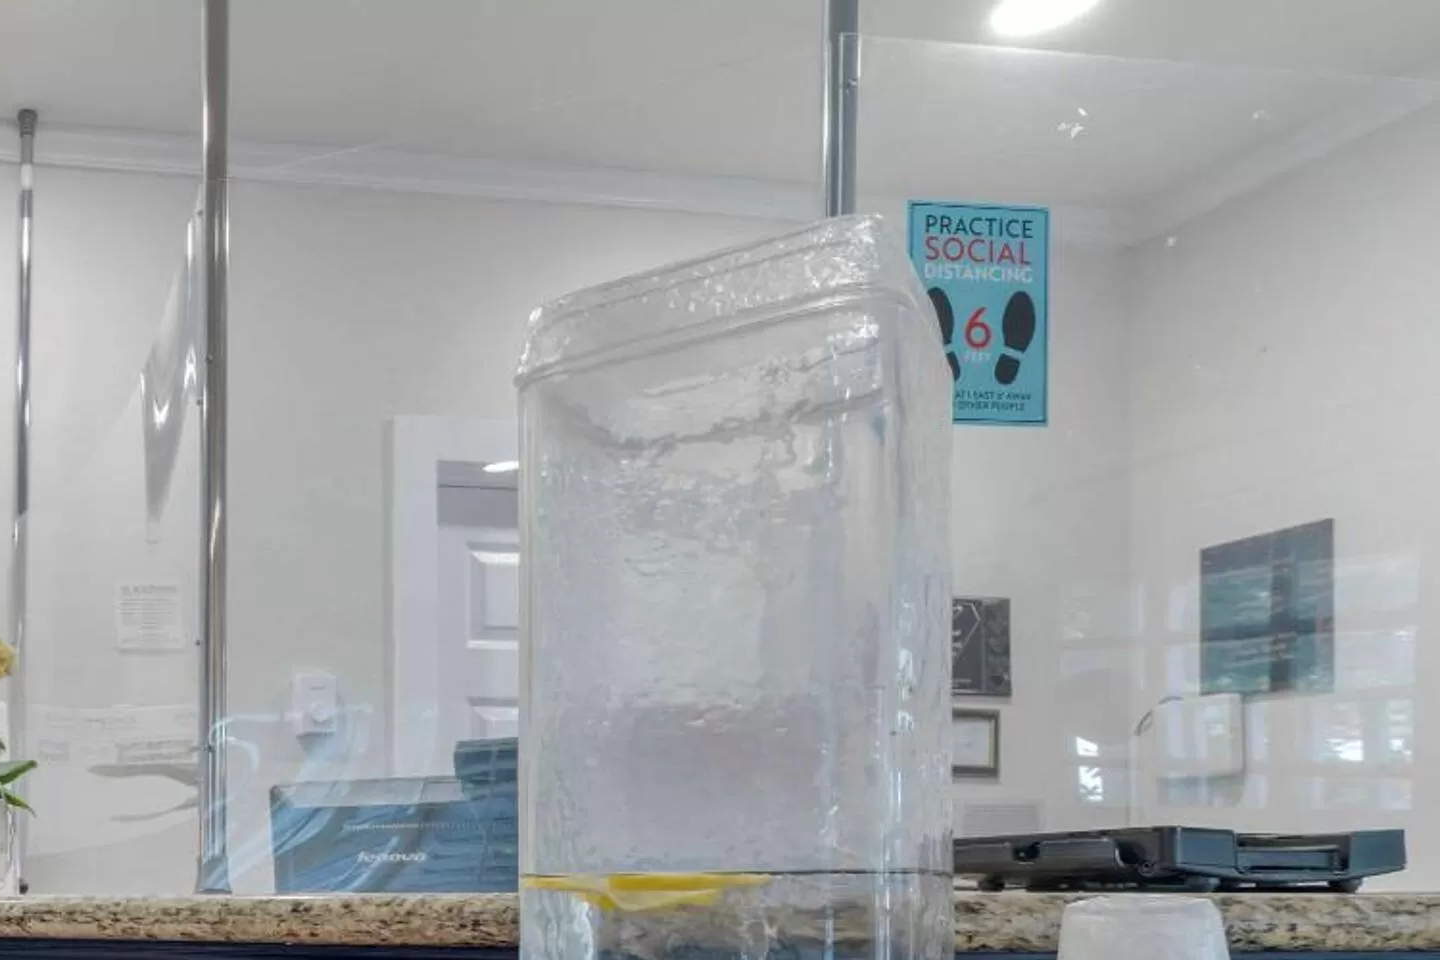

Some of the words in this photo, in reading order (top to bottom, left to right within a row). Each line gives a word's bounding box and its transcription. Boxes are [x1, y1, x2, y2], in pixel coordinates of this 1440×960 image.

[925, 214, 1034, 239] PRACTICE
[925, 236, 1032, 265] SOCIAL
[923, 262, 1034, 285] DISTANCING
[964, 306, 992, 350] 6
